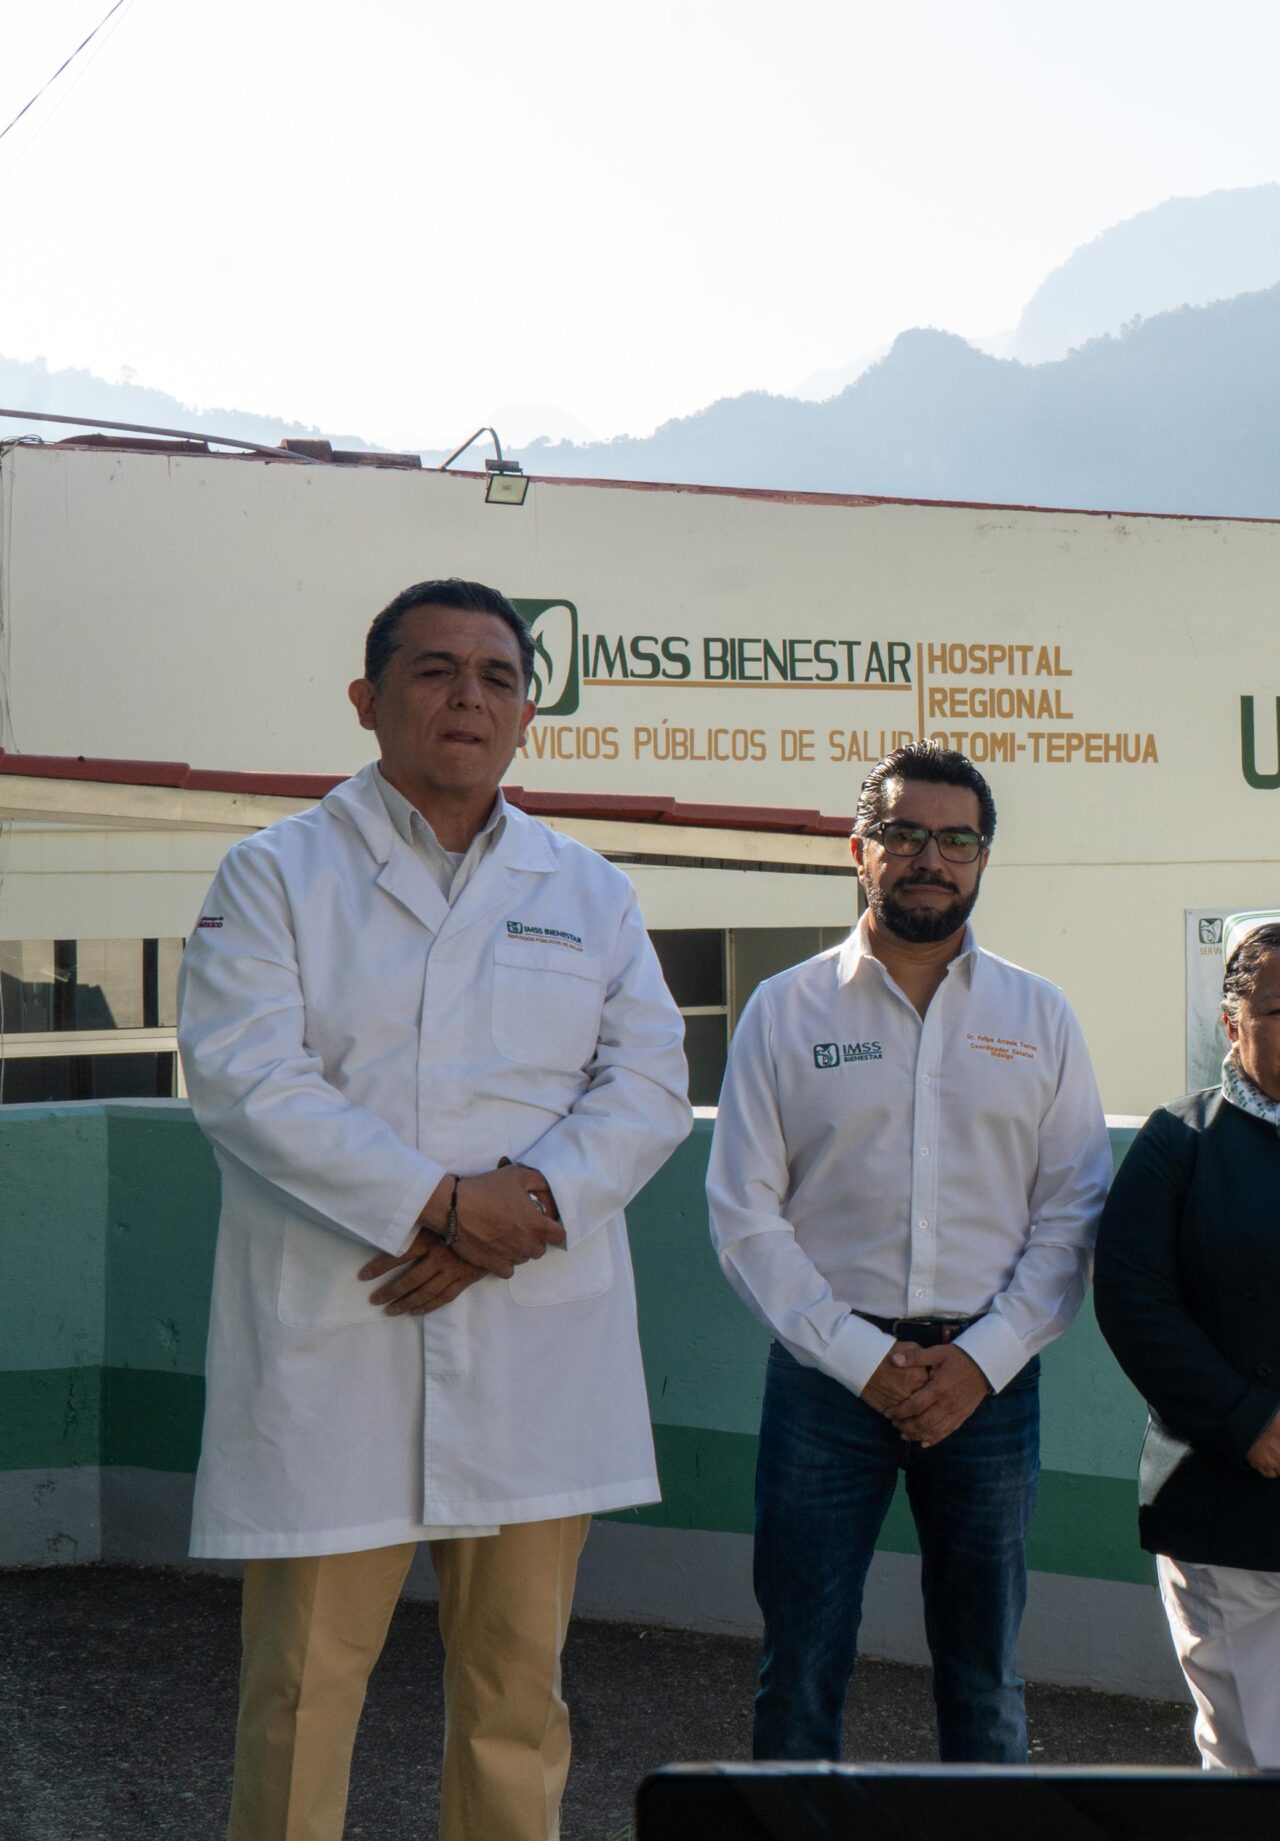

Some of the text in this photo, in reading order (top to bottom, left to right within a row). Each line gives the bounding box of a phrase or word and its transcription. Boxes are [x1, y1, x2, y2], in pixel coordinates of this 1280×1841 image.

[582, 634, 912, 683] IMSS BIENESTAR
[927, 642, 1073, 677] HOSPITAL
[928, 687, 1074, 720] REGIONAL
[633, 718, 767, 761] PÚBLICOS
[781, 729, 815, 761] DE
[524, 926, 582, 943] IMSS BIENESTAR
[843, 1041, 882, 1054] IMSS
